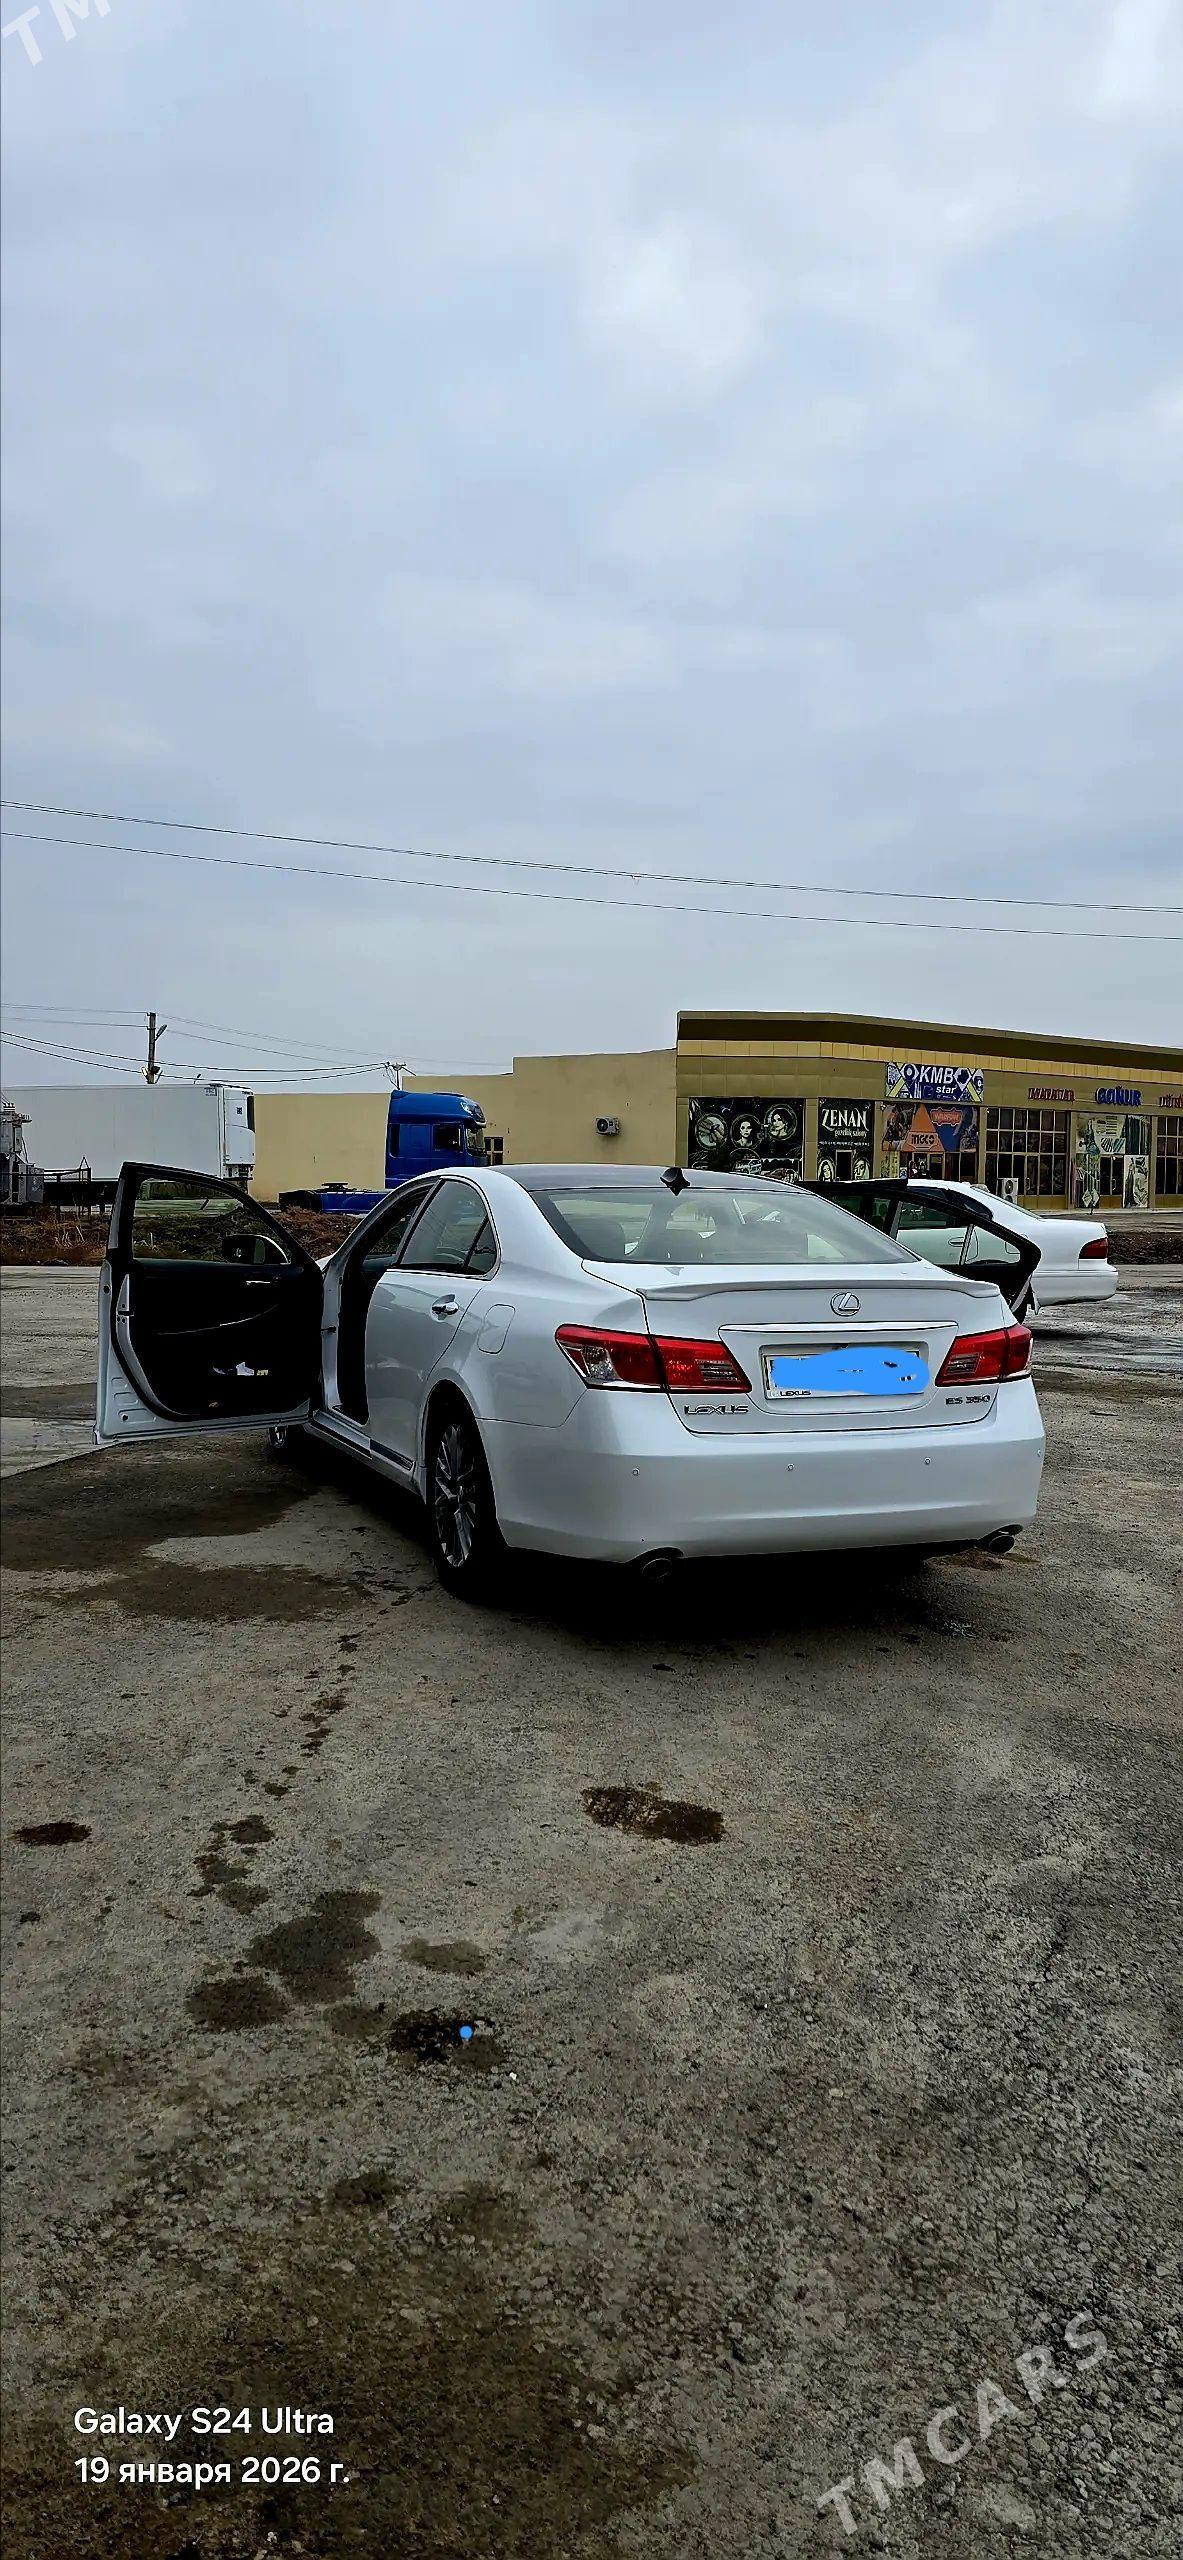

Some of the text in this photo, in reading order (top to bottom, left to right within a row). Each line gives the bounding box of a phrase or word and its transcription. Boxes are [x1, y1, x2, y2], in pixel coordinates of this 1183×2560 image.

[920, 1066, 954, 1084] KMB
[936, 1085, 956, 1094] star
[821, 1107, 870, 1131] ZENAN
[945, 1394, 991, 1405] ES 350
[684, 1404, 749, 1415] LEXUS
